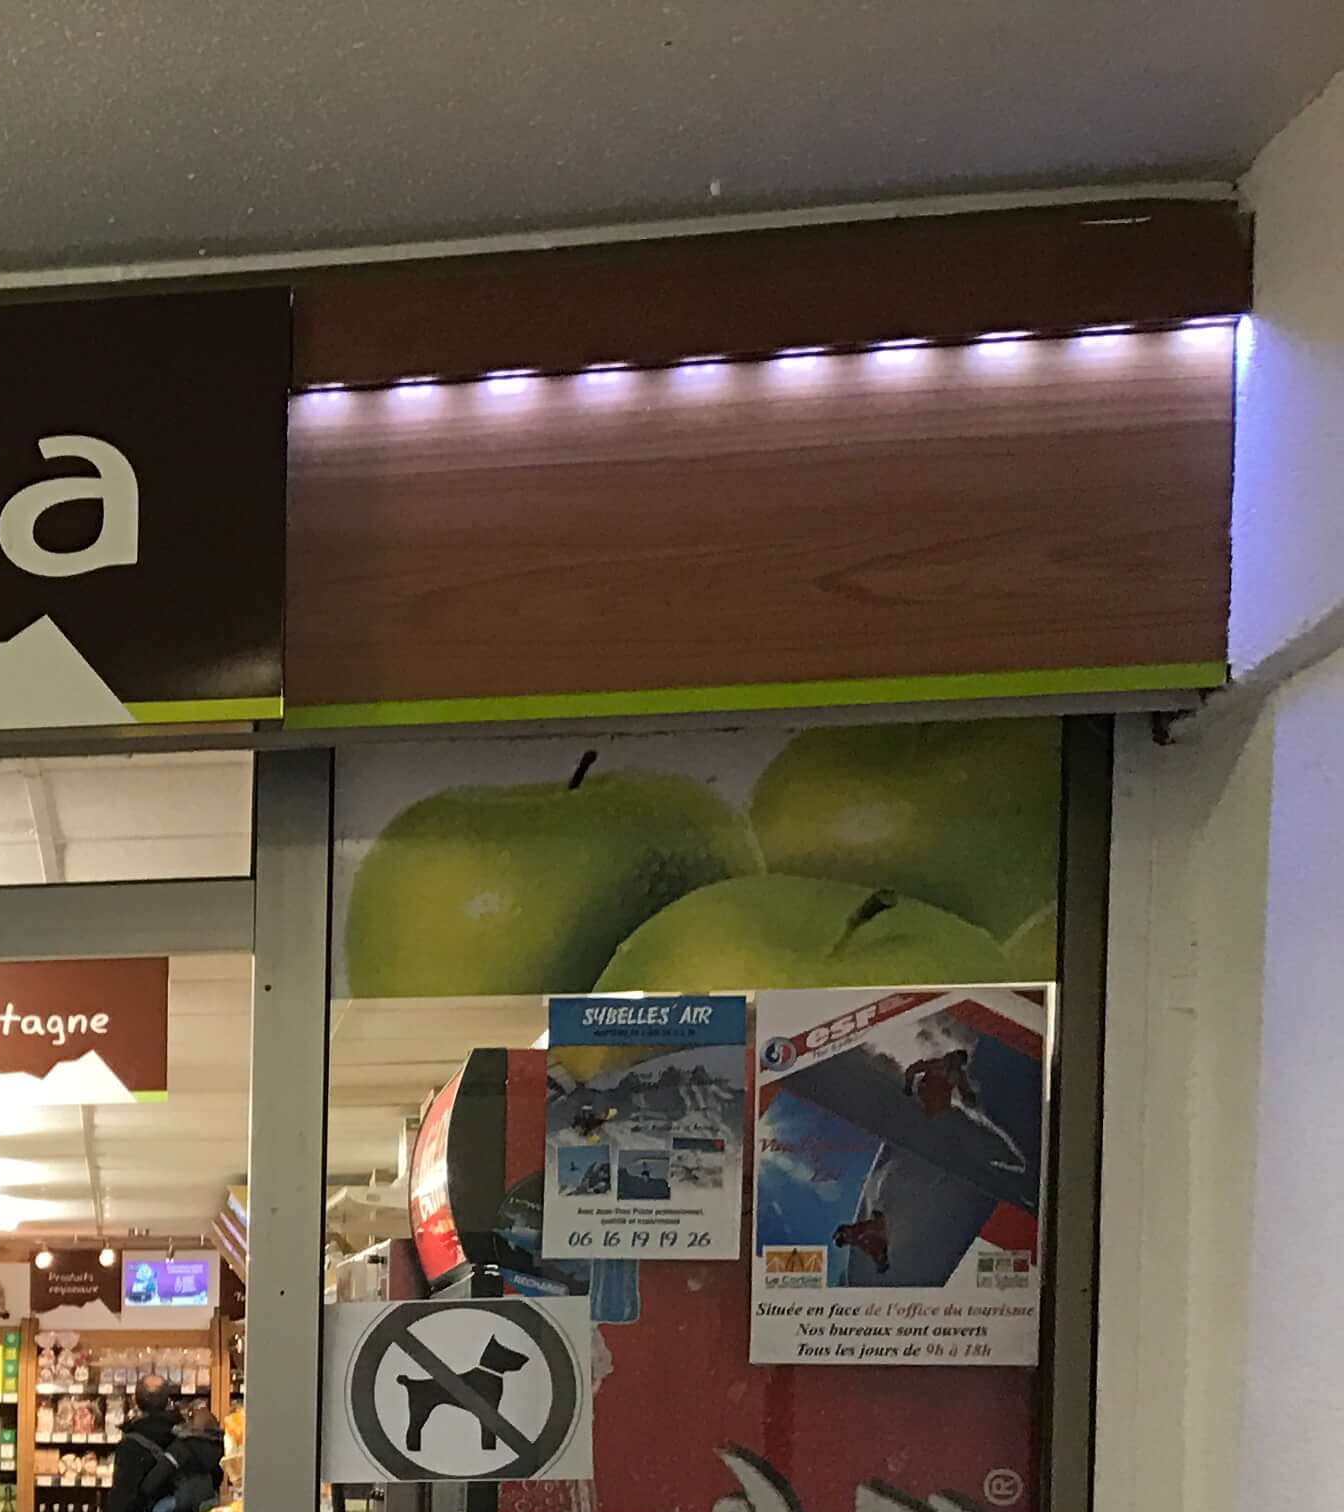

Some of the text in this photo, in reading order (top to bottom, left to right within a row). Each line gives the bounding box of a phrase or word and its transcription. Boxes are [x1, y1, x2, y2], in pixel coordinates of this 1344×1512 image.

[679, 1006, 713, 1025] AIR
[568, 1231, 712, 1248] 06 16 19 19 26
[755, 1301, 1035, 1319] Située en face de l'office du tourisme
[795, 1323, 989, 1337] Nos bureaux sont ouverts
[797, 1343, 831, 1357] Tous
[834, 1343, 856, 1357] les
[857, 1343, 901, 1360] jours
[903, 1343, 922, 1357] de
[925, 1344, 944, 1357] 9h
[963, 1344, 992, 1357] 18h
